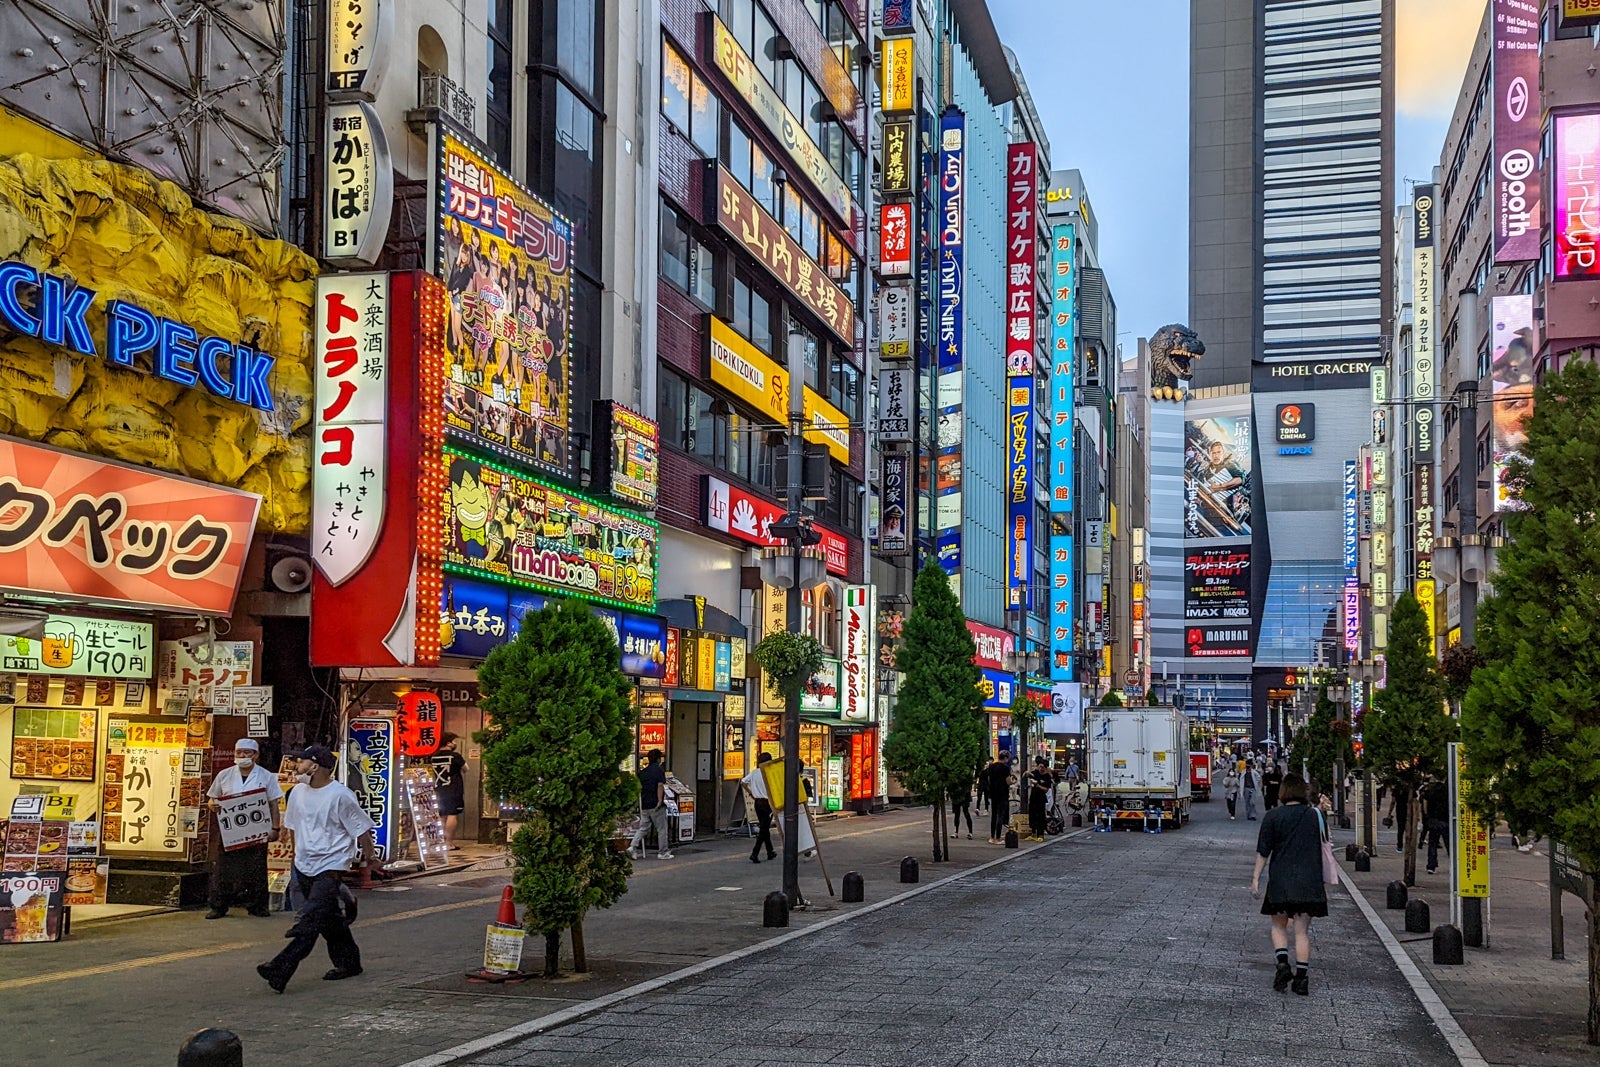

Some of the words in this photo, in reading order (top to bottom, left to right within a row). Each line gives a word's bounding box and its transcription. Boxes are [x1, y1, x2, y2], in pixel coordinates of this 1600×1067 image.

[1497, 14, 1505, 23] 6F
[1506, 16, 1516, 25] Net
[723, 37, 745, 83] 3F
[1497, 40, 1505, 49] 5F
[1506, 40, 1516, 49] Net
[336, 73, 359, 89] 1F
[332, 116, 362, 132] 新宿
[887, 126, 905, 182] 山内農場
[332, 132, 364, 221] かっぱ
[448, 152, 495, 198] 出会い
[891, 181, 902, 190] 5F
[1500, 149, 1535, 238] Booth
[450, 185, 495, 229] カフェ
[495, 194, 567, 275] キラリ
[1415, 195, 1432, 240] Booth
[333, 230, 358, 248] B1
[721, 183, 740, 223] 5F
[742, 204, 839, 327] 山内農場
[1010, 152, 1032, 342] カラオケ歌広場
[888, 263, 903, 274] 4F
[1419, 252, 1428, 302] ネットカフェ
[941, 260, 959, 342] SHINJUKU
[1420, 306, 1428, 315] &
[361, 277, 385, 381] 大衆酒場
[461, 292, 546, 356] デートに誘ってよ
[1419, 319, 1428, 353] カプセル
[107, 299, 276, 412] PECK
[712, 340, 760, 387] TORIKIZOKU
[887, 343, 903, 354] 3F
[320, 291, 360, 468] トラノコ
[1271, 364, 1312, 377] HOTEL
[1313, 362, 1373, 376] GRACERY
[1012, 389, 1029, 405] 薬
[1415, 408, 1433, 452] Booth
[1011, 411, 1030, 503] マツモトキヨシ
[1277, 446, 1312, 456] IMAX
[886, 459, 902, 503] 海の家
[321, 481, 352, 558] やきとん
[347, 465, 376, 541] やきとり
[709, 489, 727, 520] 4F
[1416, 504, 1434, 554] 甘太郎
[827, 550, 846, 568] SAKAI
[84, 621, 148, 633] アサヒスーパードライ
[454, 604, 506, 638] 立呑み
[1186, 608, 1219, 617] IMAX
[1223, 607, 1250, 617] MX4D
[1346, 593, 1358, 638] カラオケ
[85, 629, 148, 651] 生ビール
[1206, 630, 1249, 642] MARUHAN
[51, 650, 63, 660] 生
[87, 650, 145, 675] 190円
[182, 667, 249, 686] トラノコ
[442, 689, 474, 702] BLD.
[415, 699, 438, 748] 龍馬
[130, 756, 147, 766] 新宿
[365, 730, 389, 793] 立呑み
[47, 795, 74, 808] B1
[122, 765, 152, 845] かっぱ
[167, 787, 178, 837] 190円
[219, 799, 267, 815] ハイボール
[244, 831, 269, 842] トラノコ
